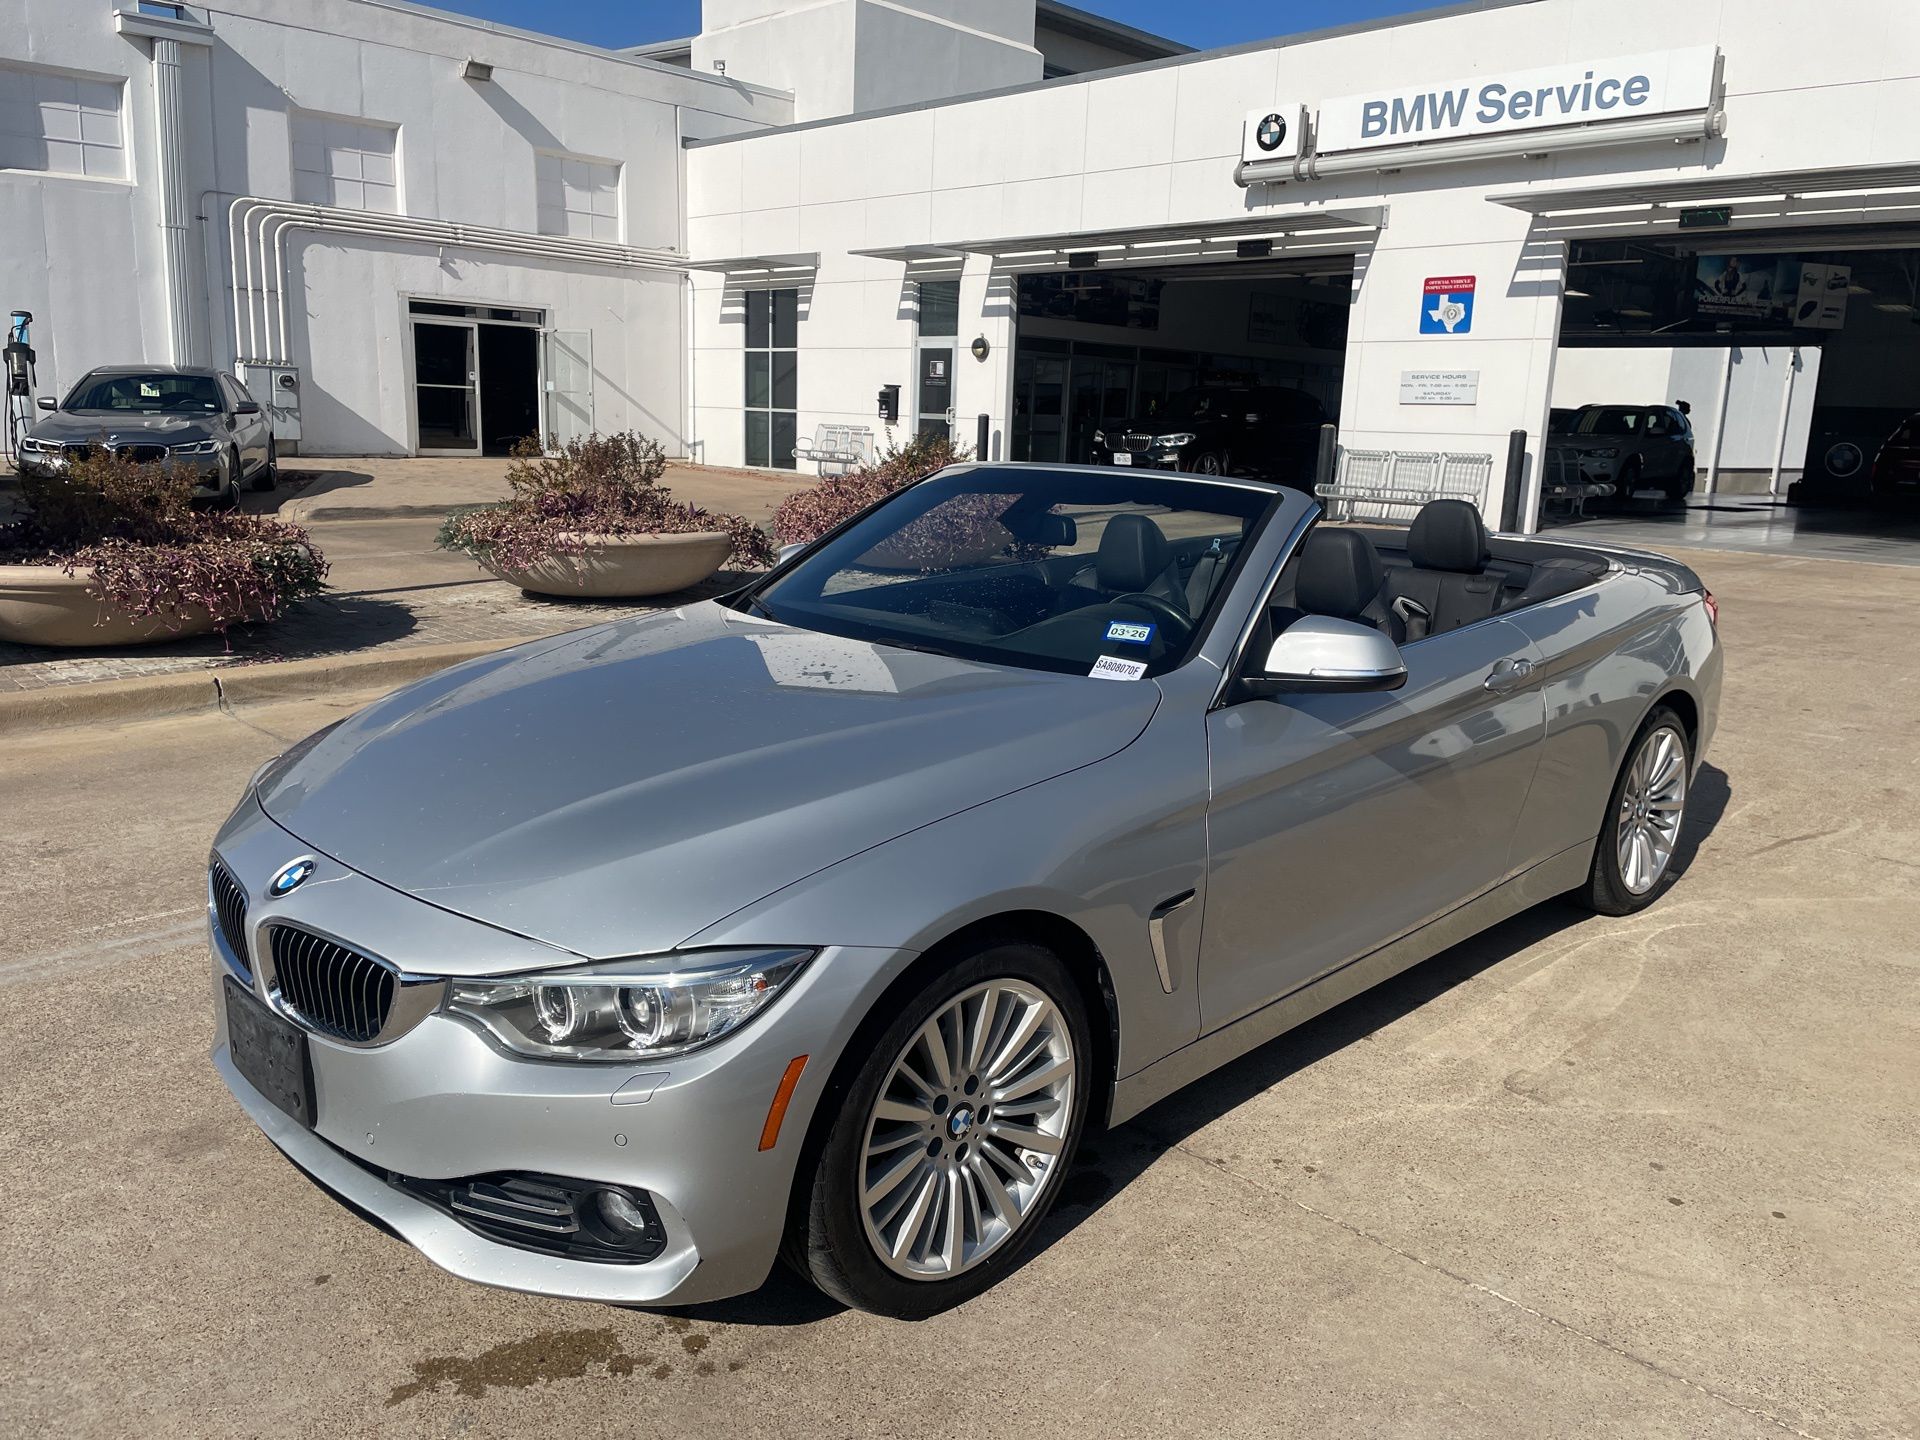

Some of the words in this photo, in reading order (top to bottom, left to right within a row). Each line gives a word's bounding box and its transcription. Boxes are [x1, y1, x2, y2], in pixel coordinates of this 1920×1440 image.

[1361, 88, 1469, 138] BMW
[1476, 71, 1651, 123] Service
[1111, 627, 1125, 636] 03
[1130, 629, 1147, 639] 26
[1096, 660, 1140, 675] SA808070F
